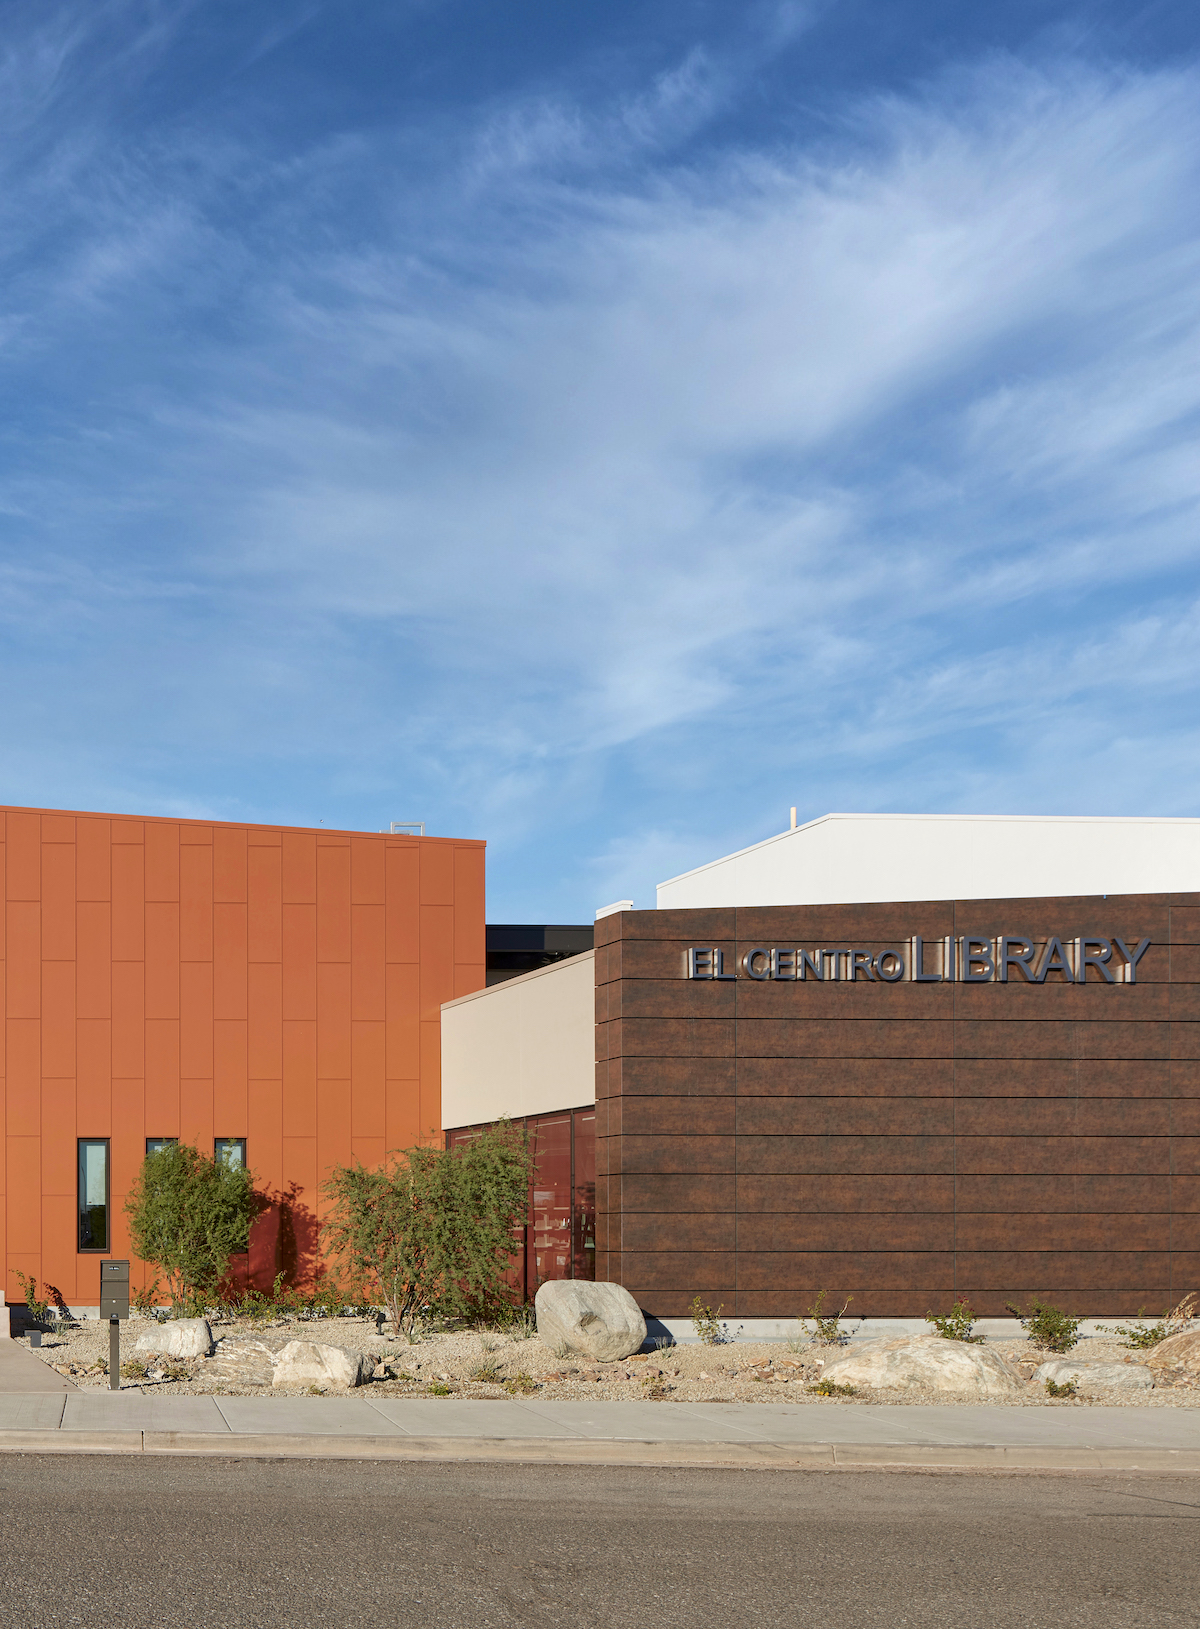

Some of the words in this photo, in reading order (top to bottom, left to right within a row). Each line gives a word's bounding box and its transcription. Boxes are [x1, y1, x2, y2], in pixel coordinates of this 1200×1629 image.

[689, 947, 736, 980] EL
[746, 947, 904, 981] CENTRO
[912, 936, 1151, 983] LIBRARY
